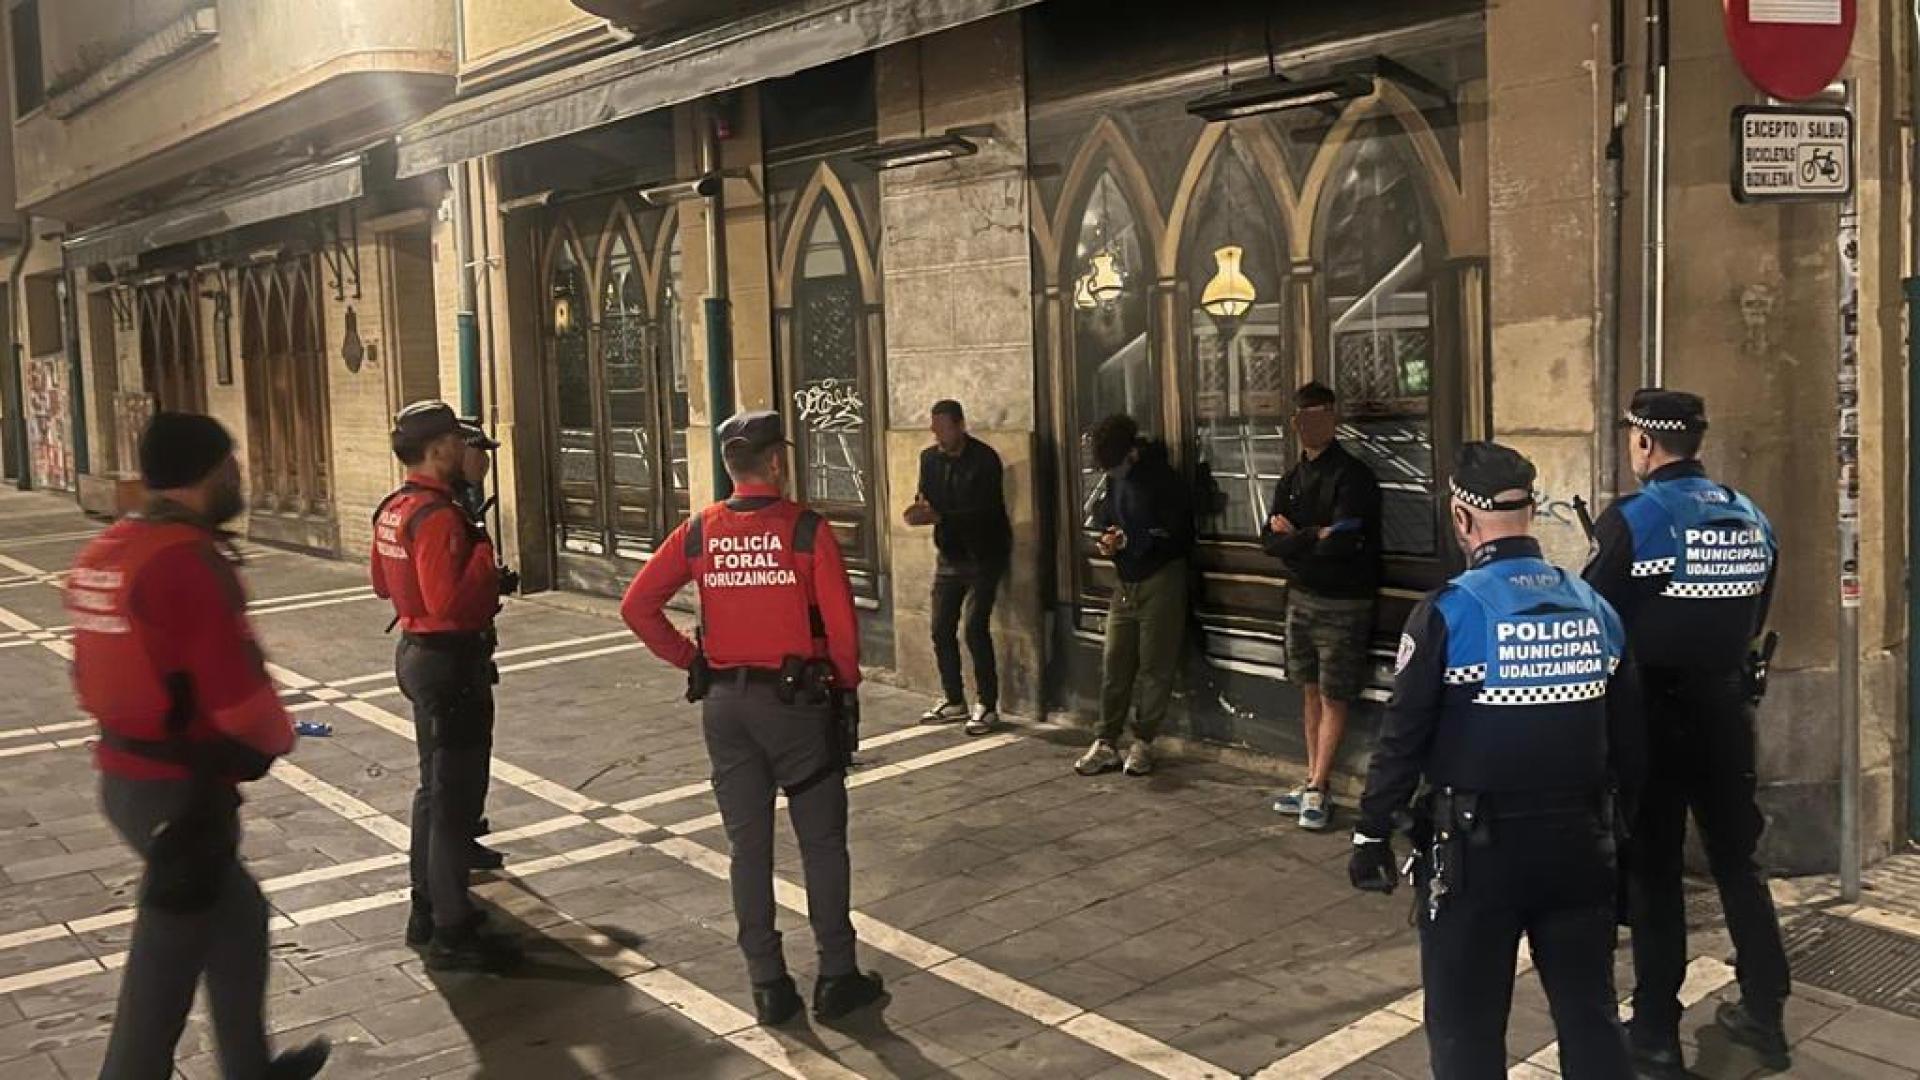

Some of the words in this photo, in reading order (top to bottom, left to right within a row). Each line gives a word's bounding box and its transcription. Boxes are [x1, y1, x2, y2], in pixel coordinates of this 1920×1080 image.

[1746, 121, 1799, 138] EXCEPTO
[1807, 121, 1844, 139] SALBU
[708, 531, 782, 553] POLICÍA
[713, 553, 779, 569] FORAL
[1686, 547, 1766, 561] MUNICIPAL
[1497, 617, 1600, 642] POLICIA
[1499, 639, 1602, 661] MUNICIPAL
[1499, 658, 1602, 679] UDALTZAINGOA
